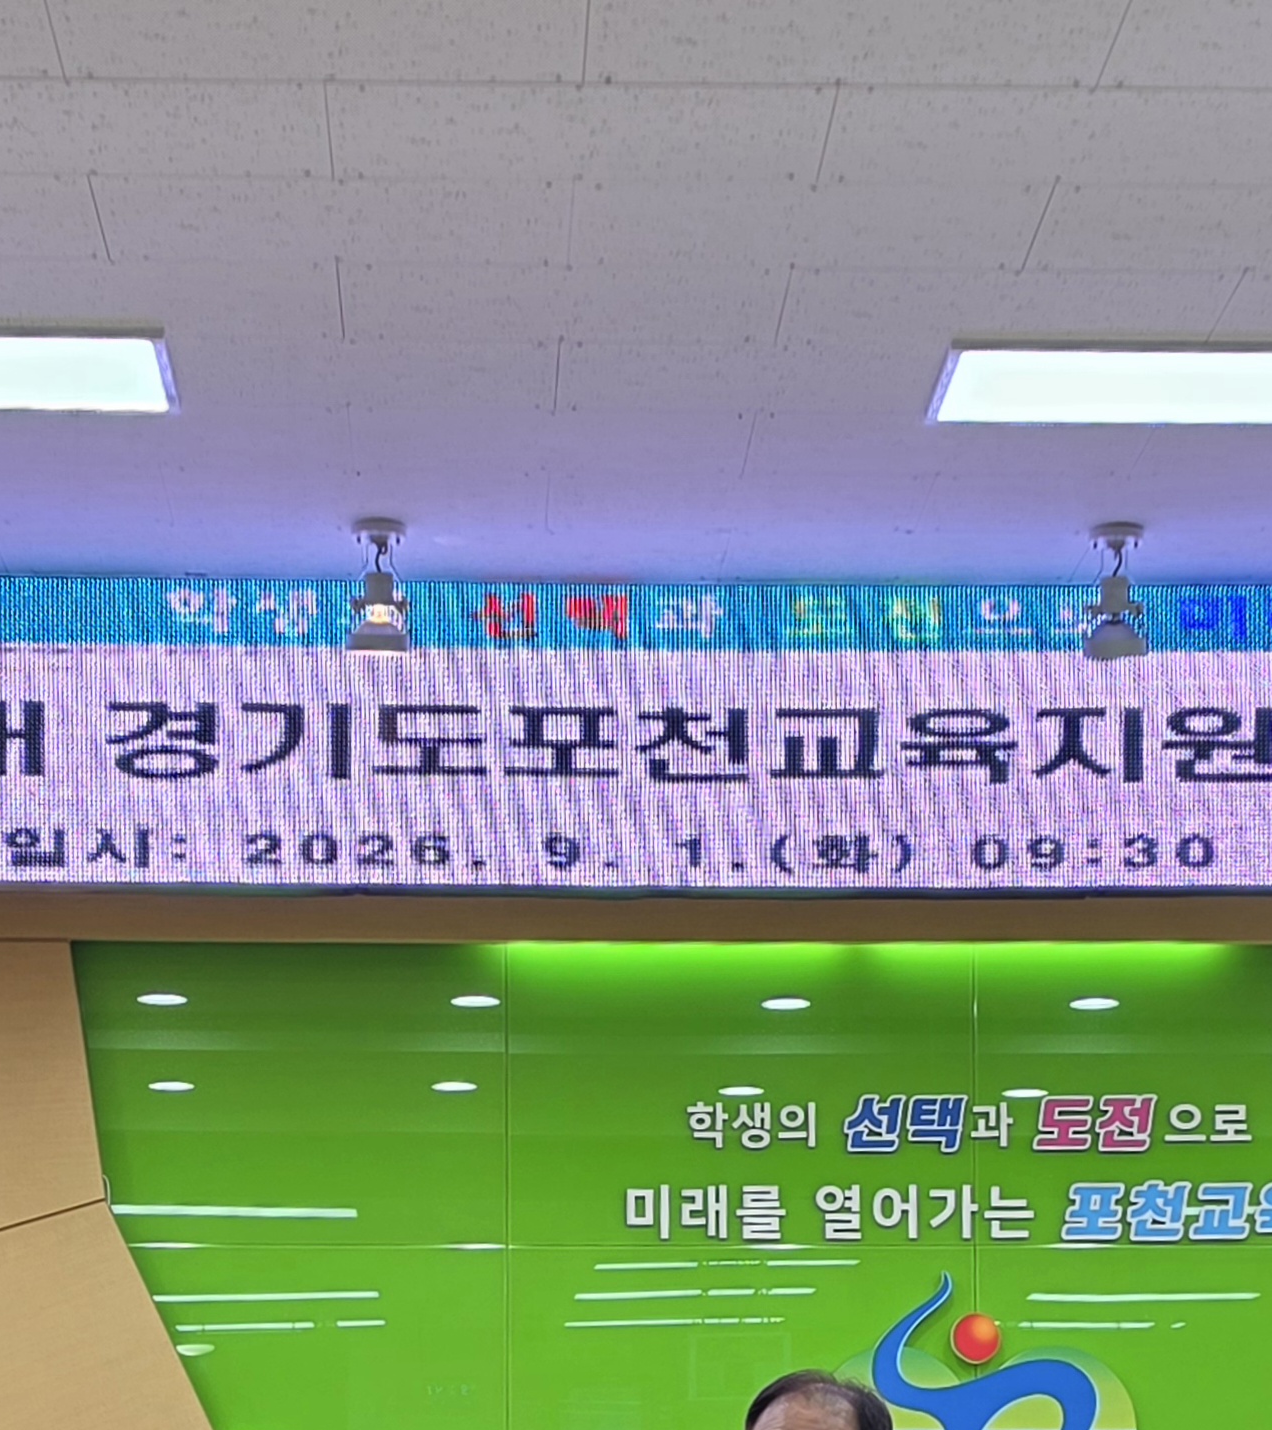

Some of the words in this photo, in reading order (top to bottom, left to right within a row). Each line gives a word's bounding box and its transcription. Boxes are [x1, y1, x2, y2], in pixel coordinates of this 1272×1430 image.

[2, 826, 189, 870] 일시:
[244, 830, 486, 872] 2026.
[972, 832, 1216, 872] 09:30
[686, 1101, 817, 1148] 학생의
[843, 1094, 1013, 1152] 선택과
[1032, 1094, 1252, 1152] 도전으로
[626, 1184, 786, 1240] 미래를
[816, 1183, 1034, 1240] 열어가는
